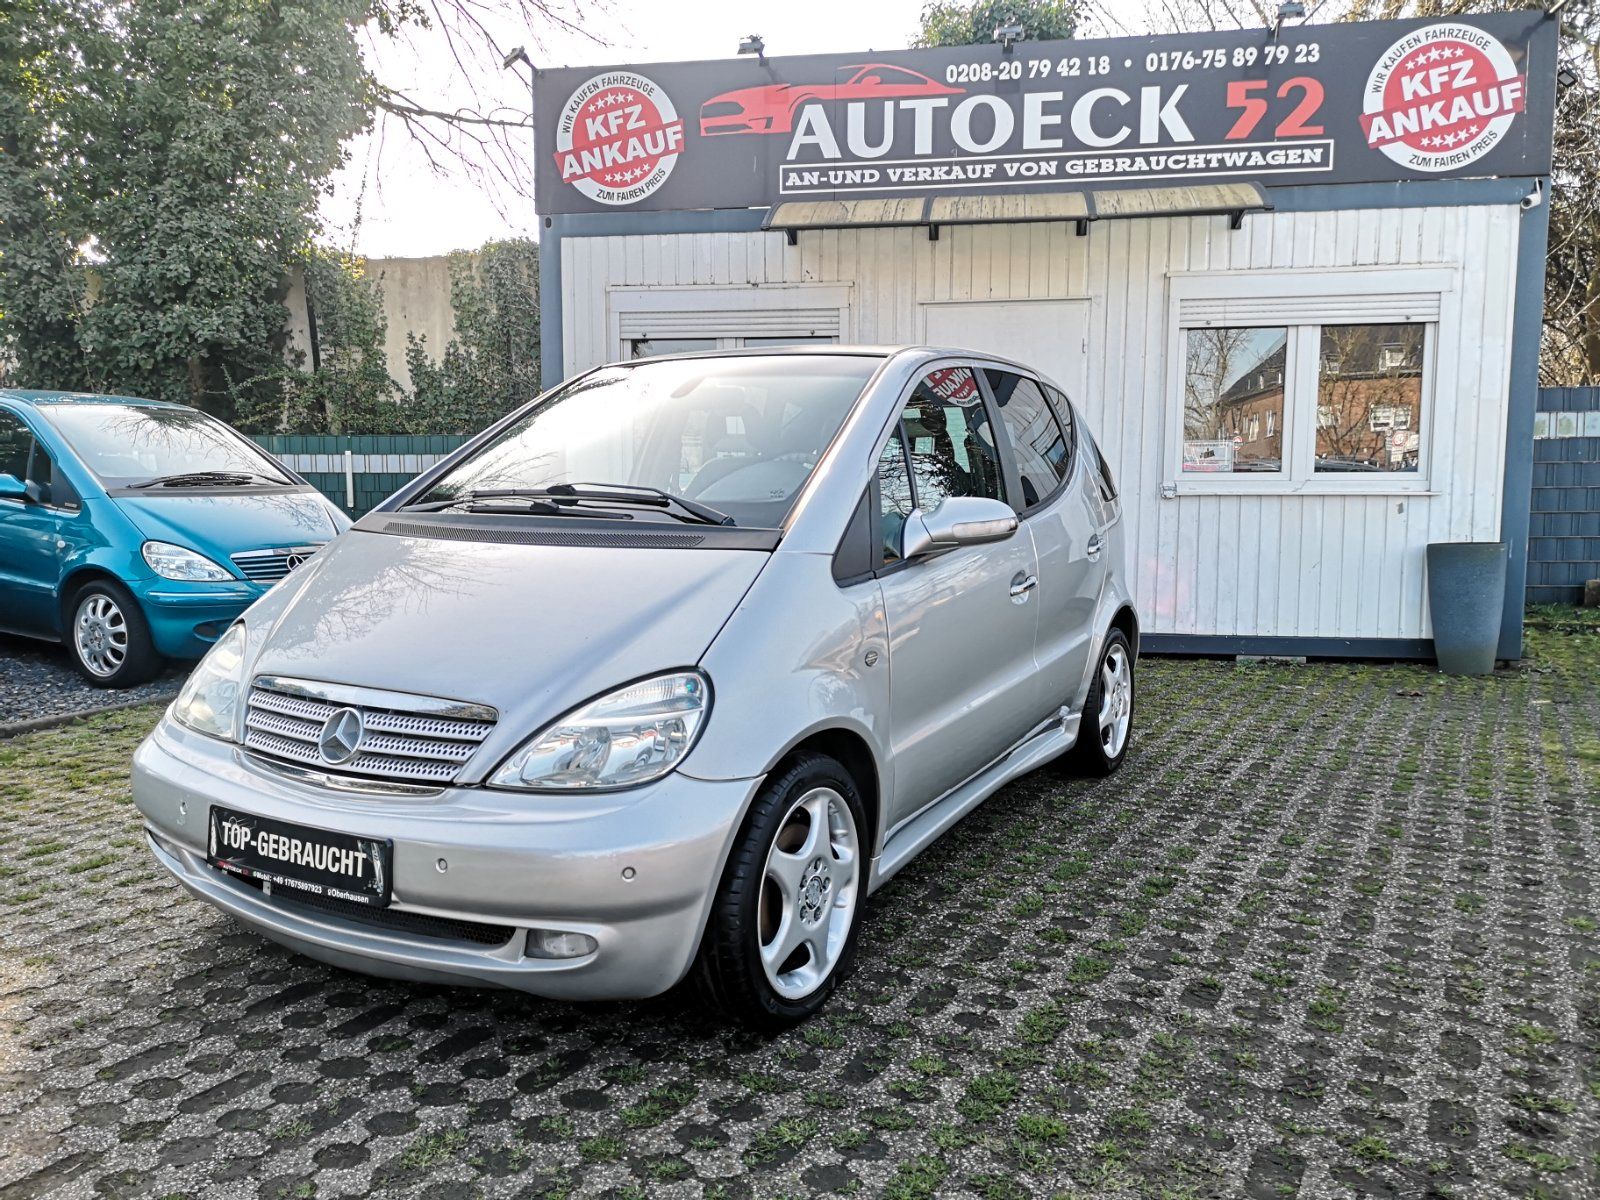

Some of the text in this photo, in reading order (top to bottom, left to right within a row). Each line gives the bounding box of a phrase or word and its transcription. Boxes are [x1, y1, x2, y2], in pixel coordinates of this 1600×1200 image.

[946, 56, 1111, 83] 0208-20 79 42 18
[1146, 43, 1320, 72] 0176-75 89 79 23
[1372, 28, 1491, 93] WIR KAUFEN FAHRZEUGE
[1401, 59, 1477, 101] KFZ
[562, 75, 655, 134] WIR KAUFEN FAHRZEUGE
[585, 104, 647, 141] KFZ
[786, 76, 1325, 160] AUTOECK 52
[1368, 81, 1522, 144] ANKAUF
[562, 125, 682, 179] ANKAUF
[785, 148, 1324, 186] AN-UND VERKAUF VON GEBRAUCHTWAGEN
[1409, 130, 1498, 167] ZUM FAIREN PREIS
[596, 168, 666, 202] ZUM FAIREN PREIS
[222, 821, 367, 878] TOP-GEBRAUCHT
[273, 876, 284, 885] +49
[332, 888, 369, 904] Oberhausen
